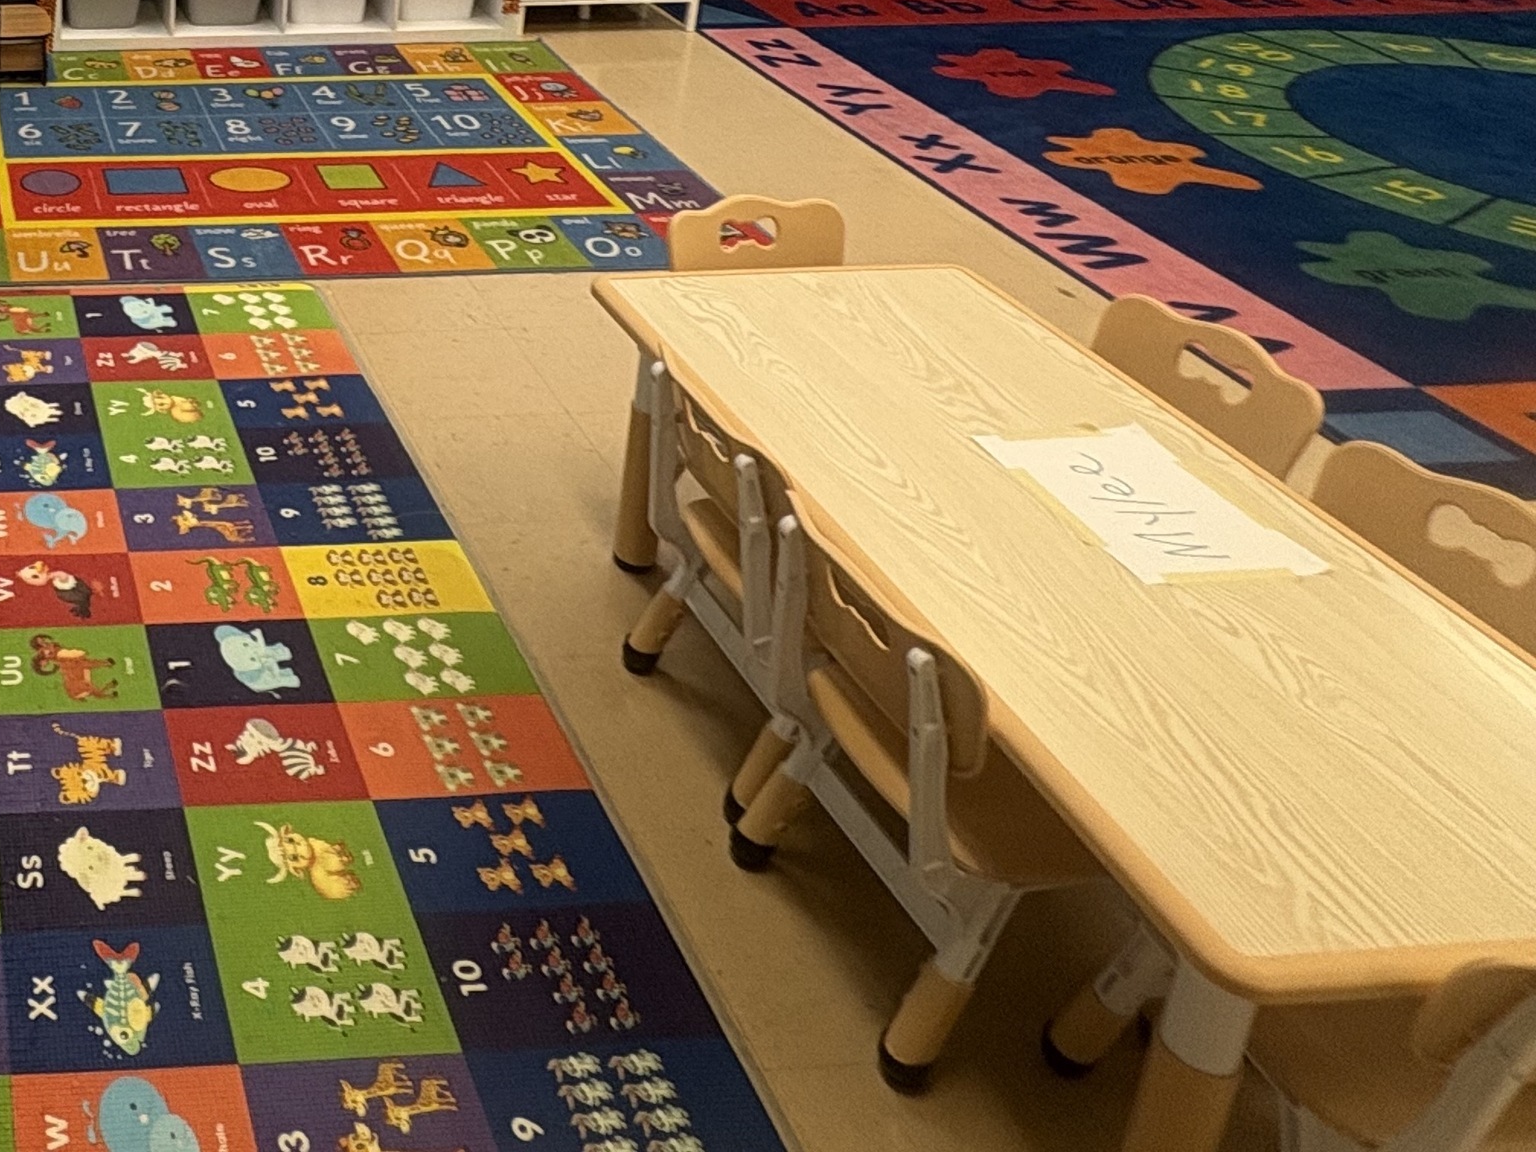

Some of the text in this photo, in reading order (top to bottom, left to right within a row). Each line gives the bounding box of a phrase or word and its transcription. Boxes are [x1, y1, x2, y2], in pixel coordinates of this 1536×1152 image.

[1198, 57, 1255, 76] 19
[210, 88, 232, 102] 3
[312, 86, 336, 98] 4
[404, 84, 431, 98] 5
[1189, 78, 1249, 99] 18
[15, 92, 30, 105] 1
[107, 90, 133, 104] 2
[330, 117, 357, 132] 9
[431, 114, 482, 130] 10
[1211, 110, 1266, 127] 17
[18, 124, 42, 139] 6
[118, 122, 141, 136] 7
[225, 119, 251, 134] 8
[1073, 154, 1182, 165] orange
[1272, 146, 1344, 164] 16
[436, 193, 506, 206] triangle
[545, 192, 579, 203] star
[1373, 180, 1446, 204] 15
[33, 203, 82, 214] circle
[116, 201, 200, 214] rectangle
[243, 199, 279, 209] oval
[338, 197, 399, 210] square
[105, 229, 137, 237] tree
[195, 227, 236, 235] snow
[289, 225, 323, 235] ring
[395, 239, 457, 264] Qq
[486, 239, 547, 265] Pp
[584, 236, 642, 258] Oo
[17, 251, 72, 273] Uu
[110, 249, 152, 270] Tt
[207, 247, 257, 268] Ss
[299, 245, 354, 267] Rr
[257, 447, 278, 462] 10
[134, 513, 154, 524] 3
[150, 579, 173, 592] 2
[308, 576, 328, 586] 8
[168, 660, 193, 670] 1
[335, 653, 360, 666] 7
[1, 655, 24, 685] Uu
[190, 741, 217, 773] Zz
[369, 742, 395, 757] 6
[7, 751, 34, 775] Tt
[409, 847, 437, 864] 5
[17, 854, 45, 889] Ss
[165, 850, 177, 881] Sheep
[216, 846, 247, 882] Yy
[452, 959, 488, 996] 10
[241, 977, 271, 999] 4
[28, 975, 59, 1021] Xx
